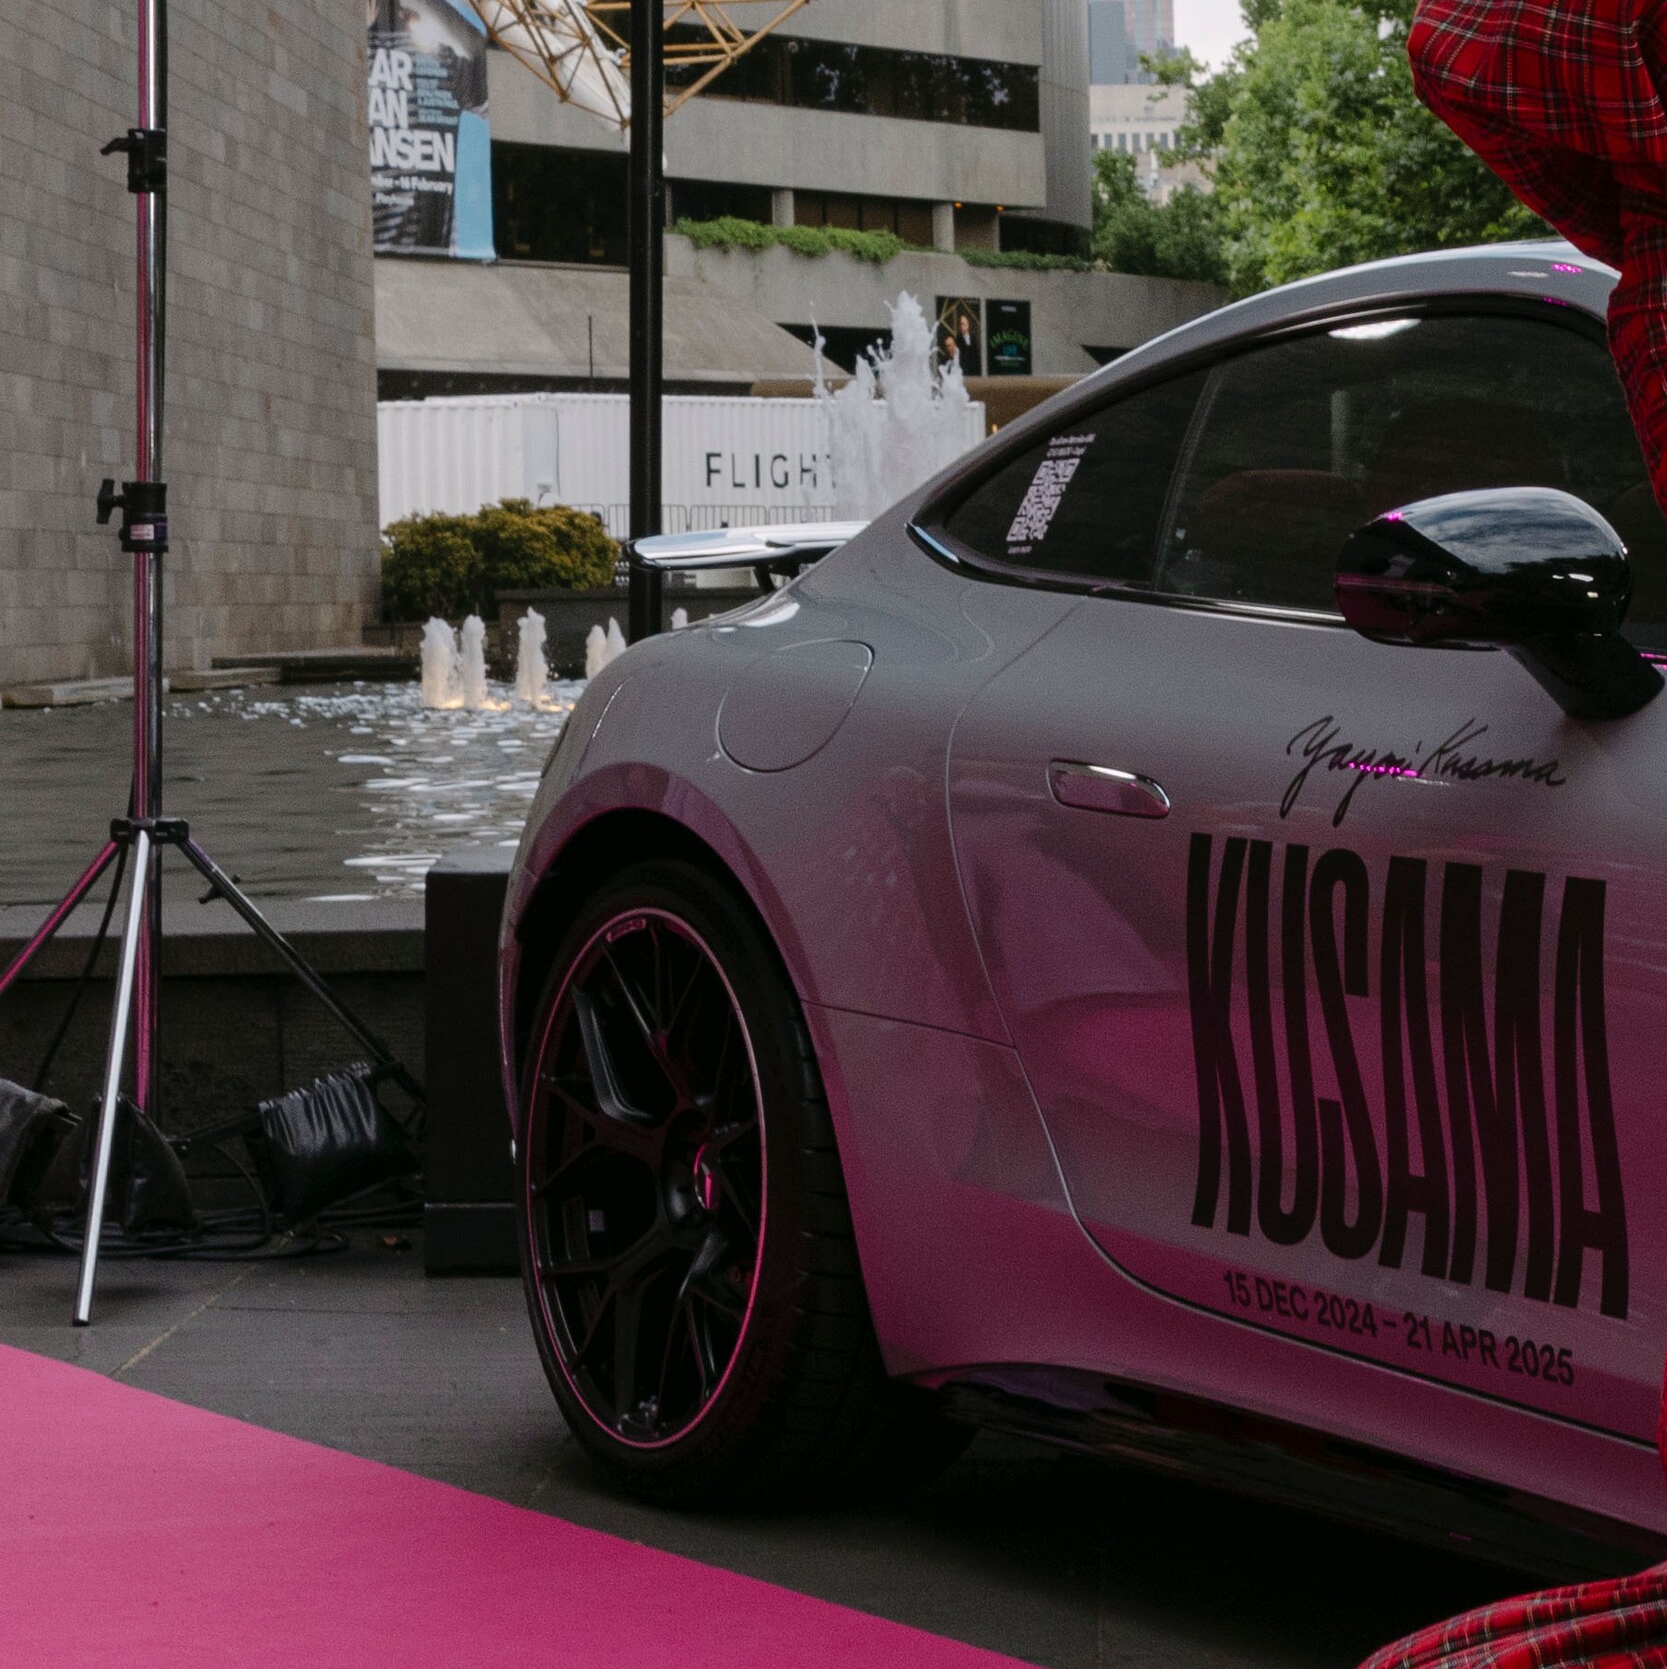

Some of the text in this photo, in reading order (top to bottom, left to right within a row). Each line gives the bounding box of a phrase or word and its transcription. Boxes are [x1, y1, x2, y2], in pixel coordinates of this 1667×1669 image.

[1416, 718, 1566, 786] Kusama
[1187, 832, 1629, 1320] KUSAMA
[1224, 1270, 1250, 1307] 15
[1256, 1277, 1309, 1320] DEC
[1314, 1291, 1378, 1338] 2024
[1404, 1312, 1433, 1351] 21
[1441, 1322, 1499, 1368] APR
[1505, 1335, 1575, 1386] 2025
